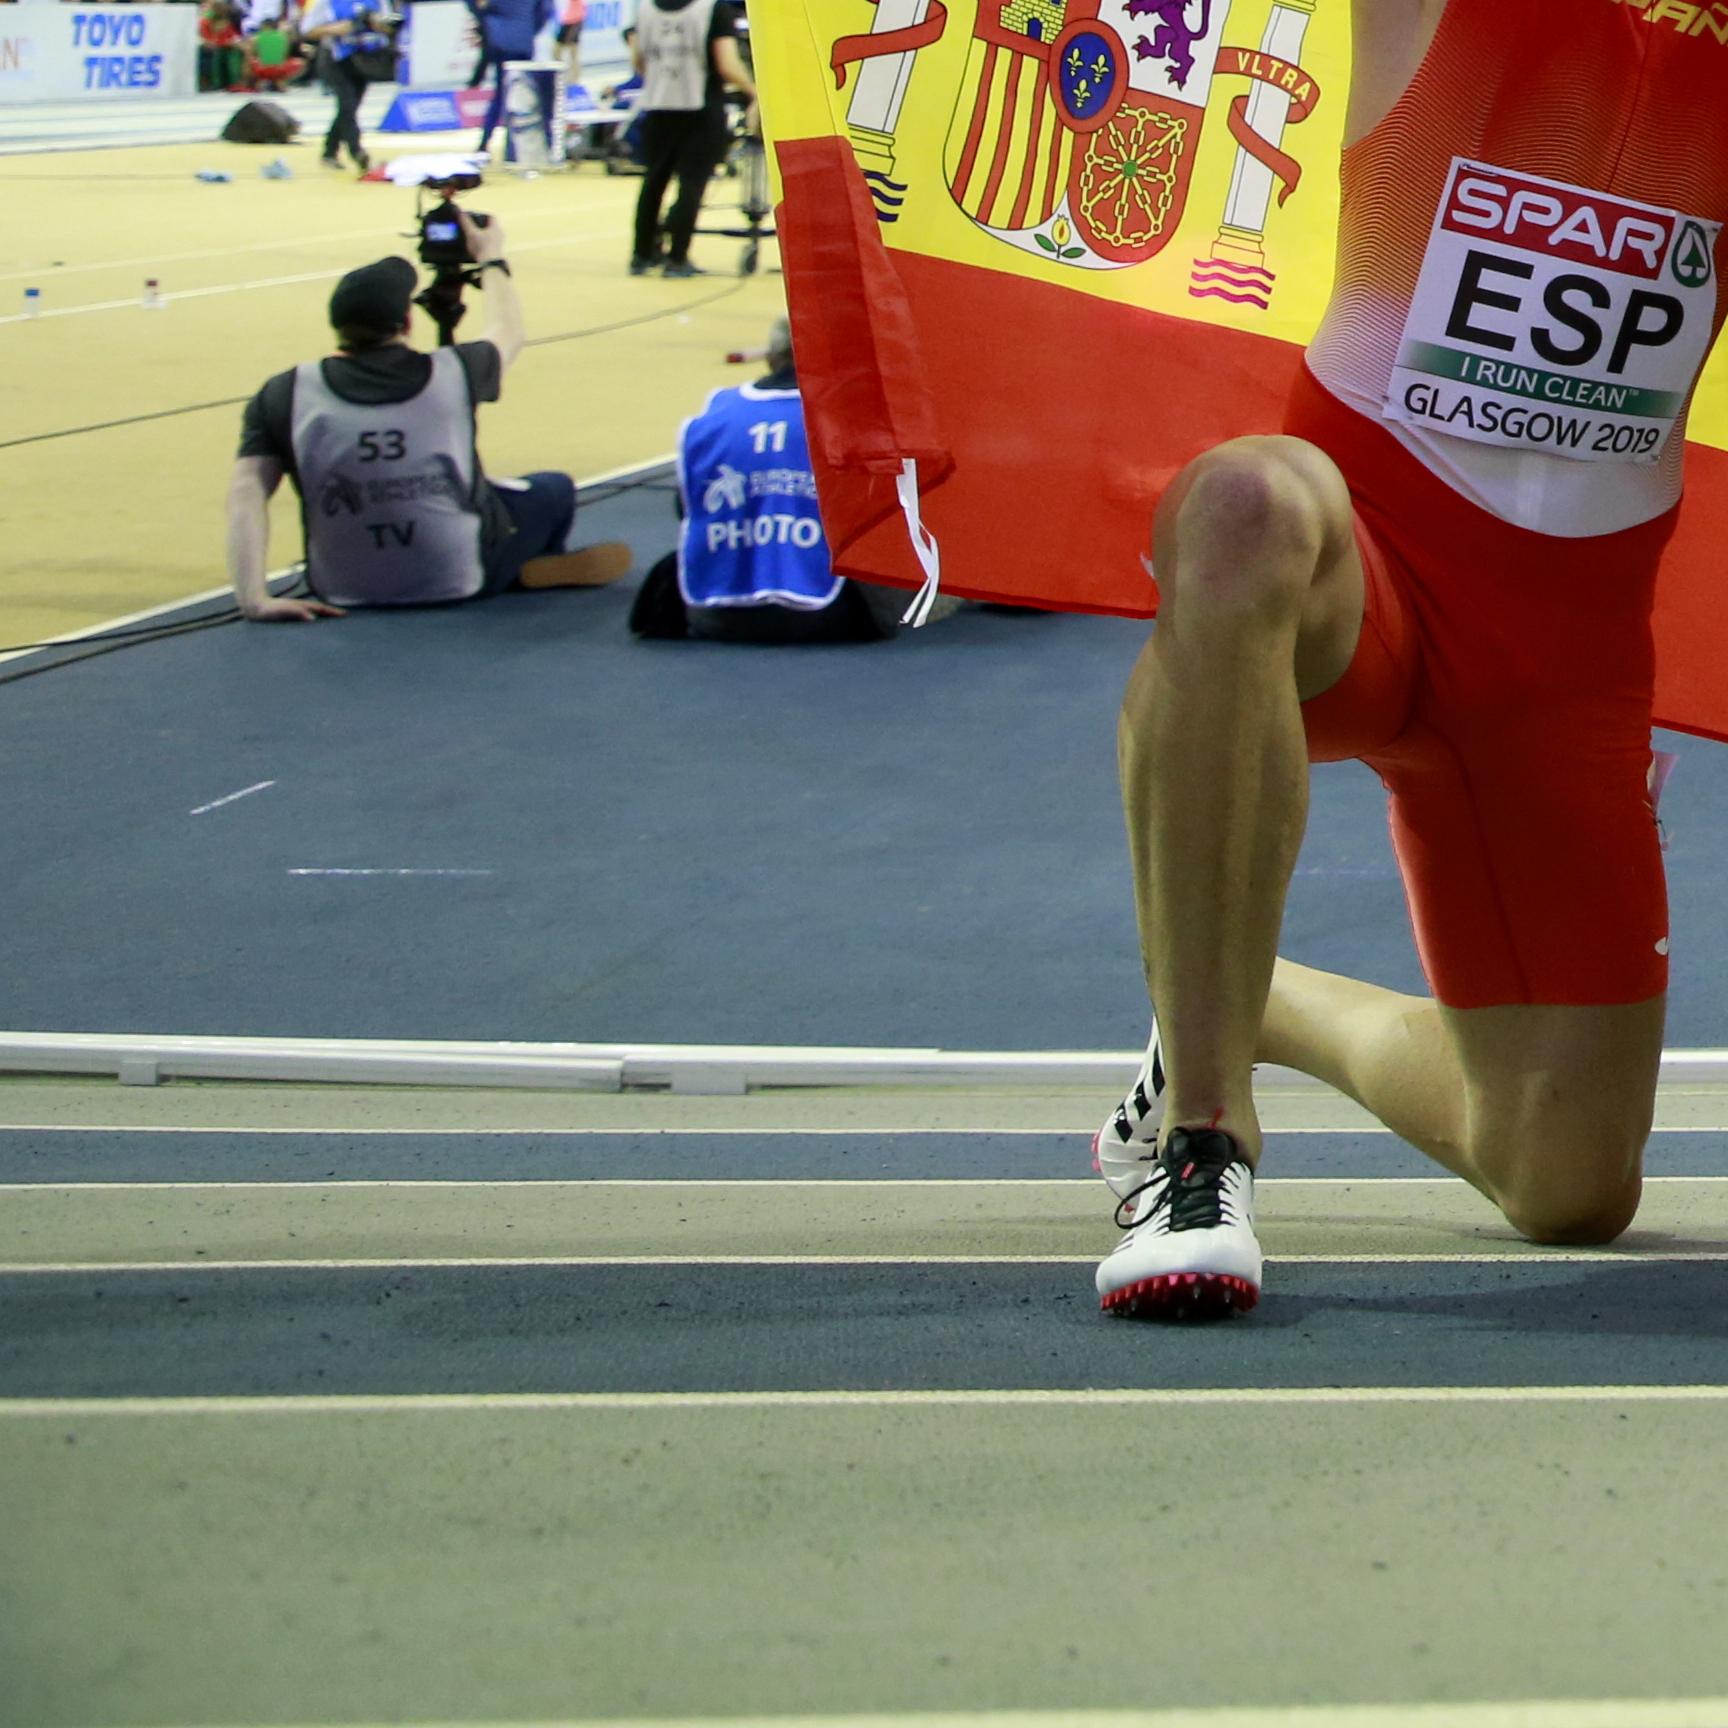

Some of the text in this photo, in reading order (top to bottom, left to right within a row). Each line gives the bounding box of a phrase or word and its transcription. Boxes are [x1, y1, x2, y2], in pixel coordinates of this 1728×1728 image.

[71, 14, 146, 47] TOYO
[83, 55, 163, 88] TIRES
[1238, 52, 1311, 101] VLTRA
[1451, 177, 1666, 269] SPAR
[1445, 249, 1684, 374] ESP
[1460, 356, 1470, 377] I
[1476, 360, 1539, 393] RUN
[1404, 383, 1660, 454] GLASGOW 2019
[358, 429, 407, 463] 53
[748, 421, 788, 454] 11
[367, 521, 415, 549] TV
[706, 514, 822, 553] PHOTO
